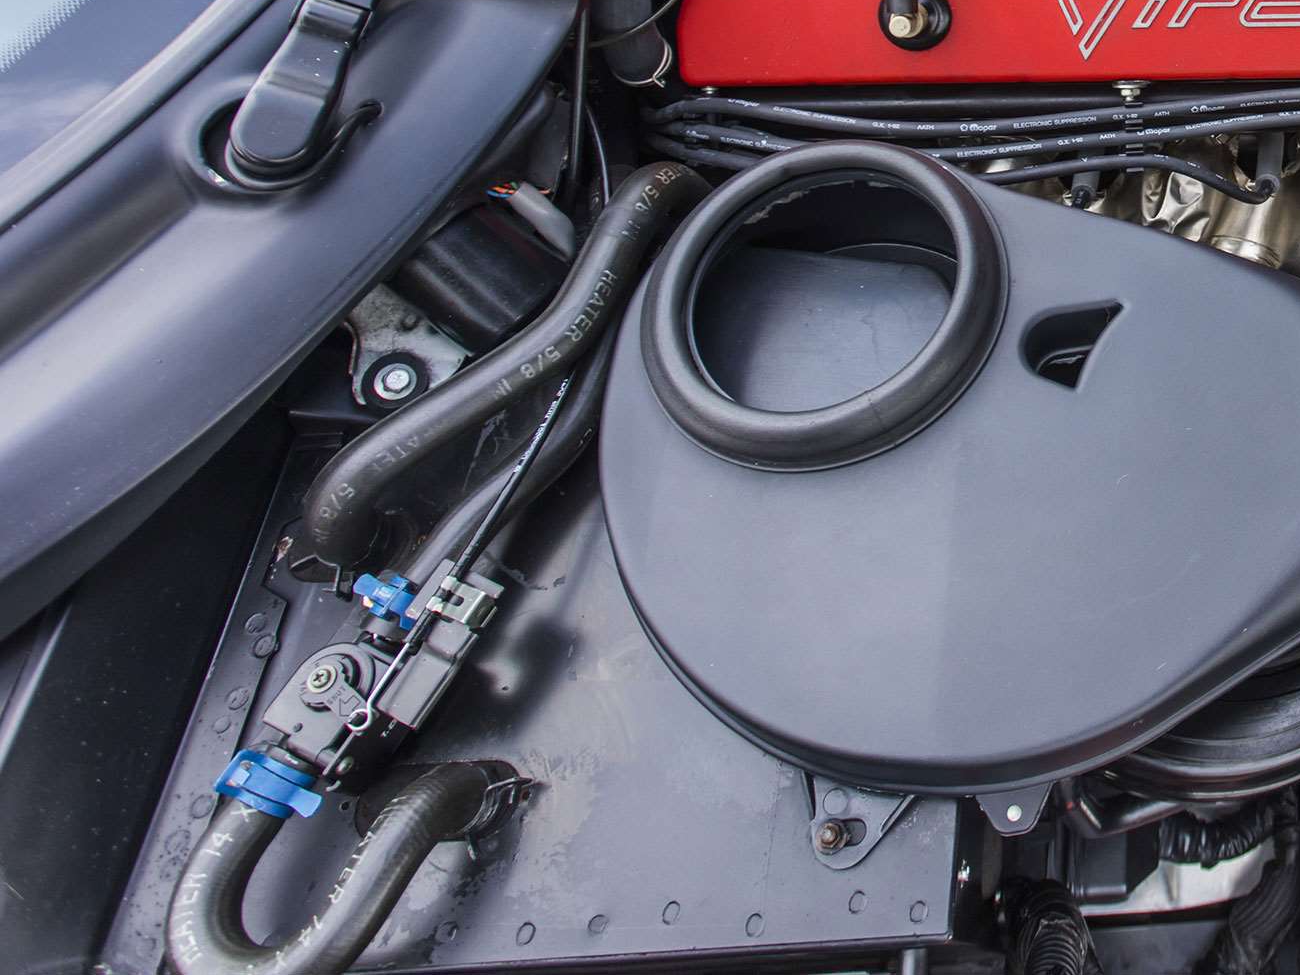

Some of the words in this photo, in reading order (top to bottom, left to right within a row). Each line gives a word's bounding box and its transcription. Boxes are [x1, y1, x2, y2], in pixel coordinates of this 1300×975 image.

[1054, 116, 1097, 126] SUPPRESSION
[957, 147, 998, 158] ELECTRONIC
[999, 142, 1043, 155] SUPPRESSION
[564, 269, 617, 342] HEATER
[520, 345, 562, 379] 5/8
